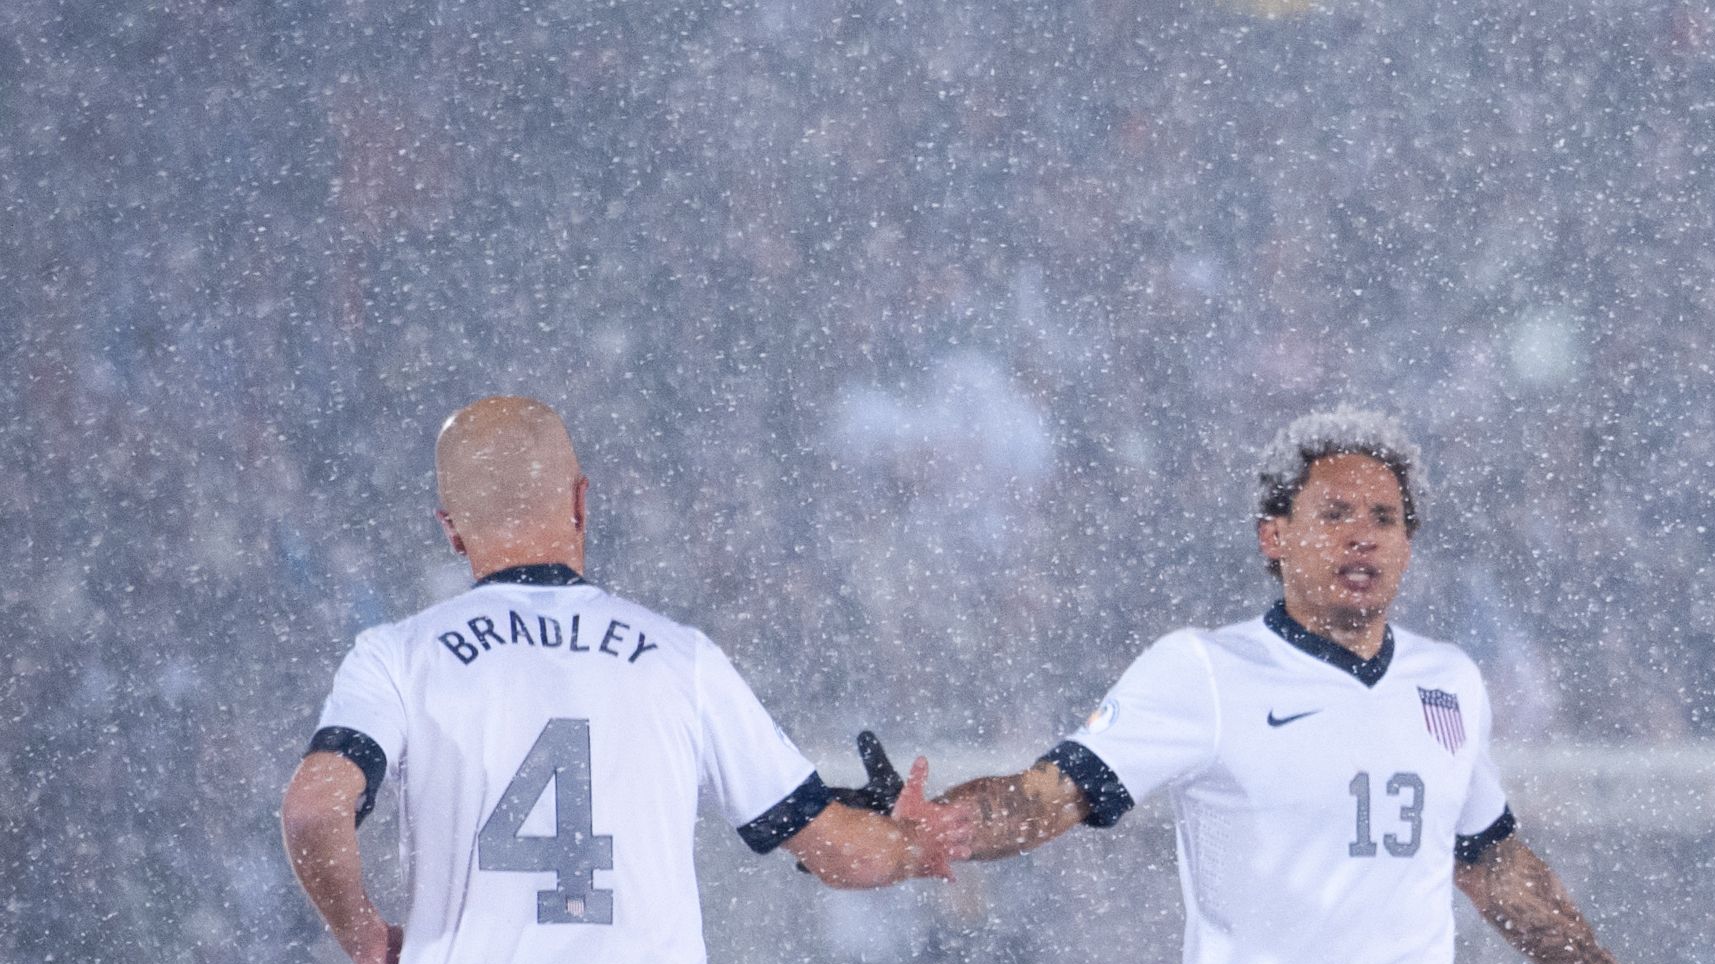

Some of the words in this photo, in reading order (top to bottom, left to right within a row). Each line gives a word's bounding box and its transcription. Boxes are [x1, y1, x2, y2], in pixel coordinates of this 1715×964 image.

[437, 609, 658, 665] BRADLEY
[477, 717, 614, 925] 4
[1348, 771, 1426, 858] 13
